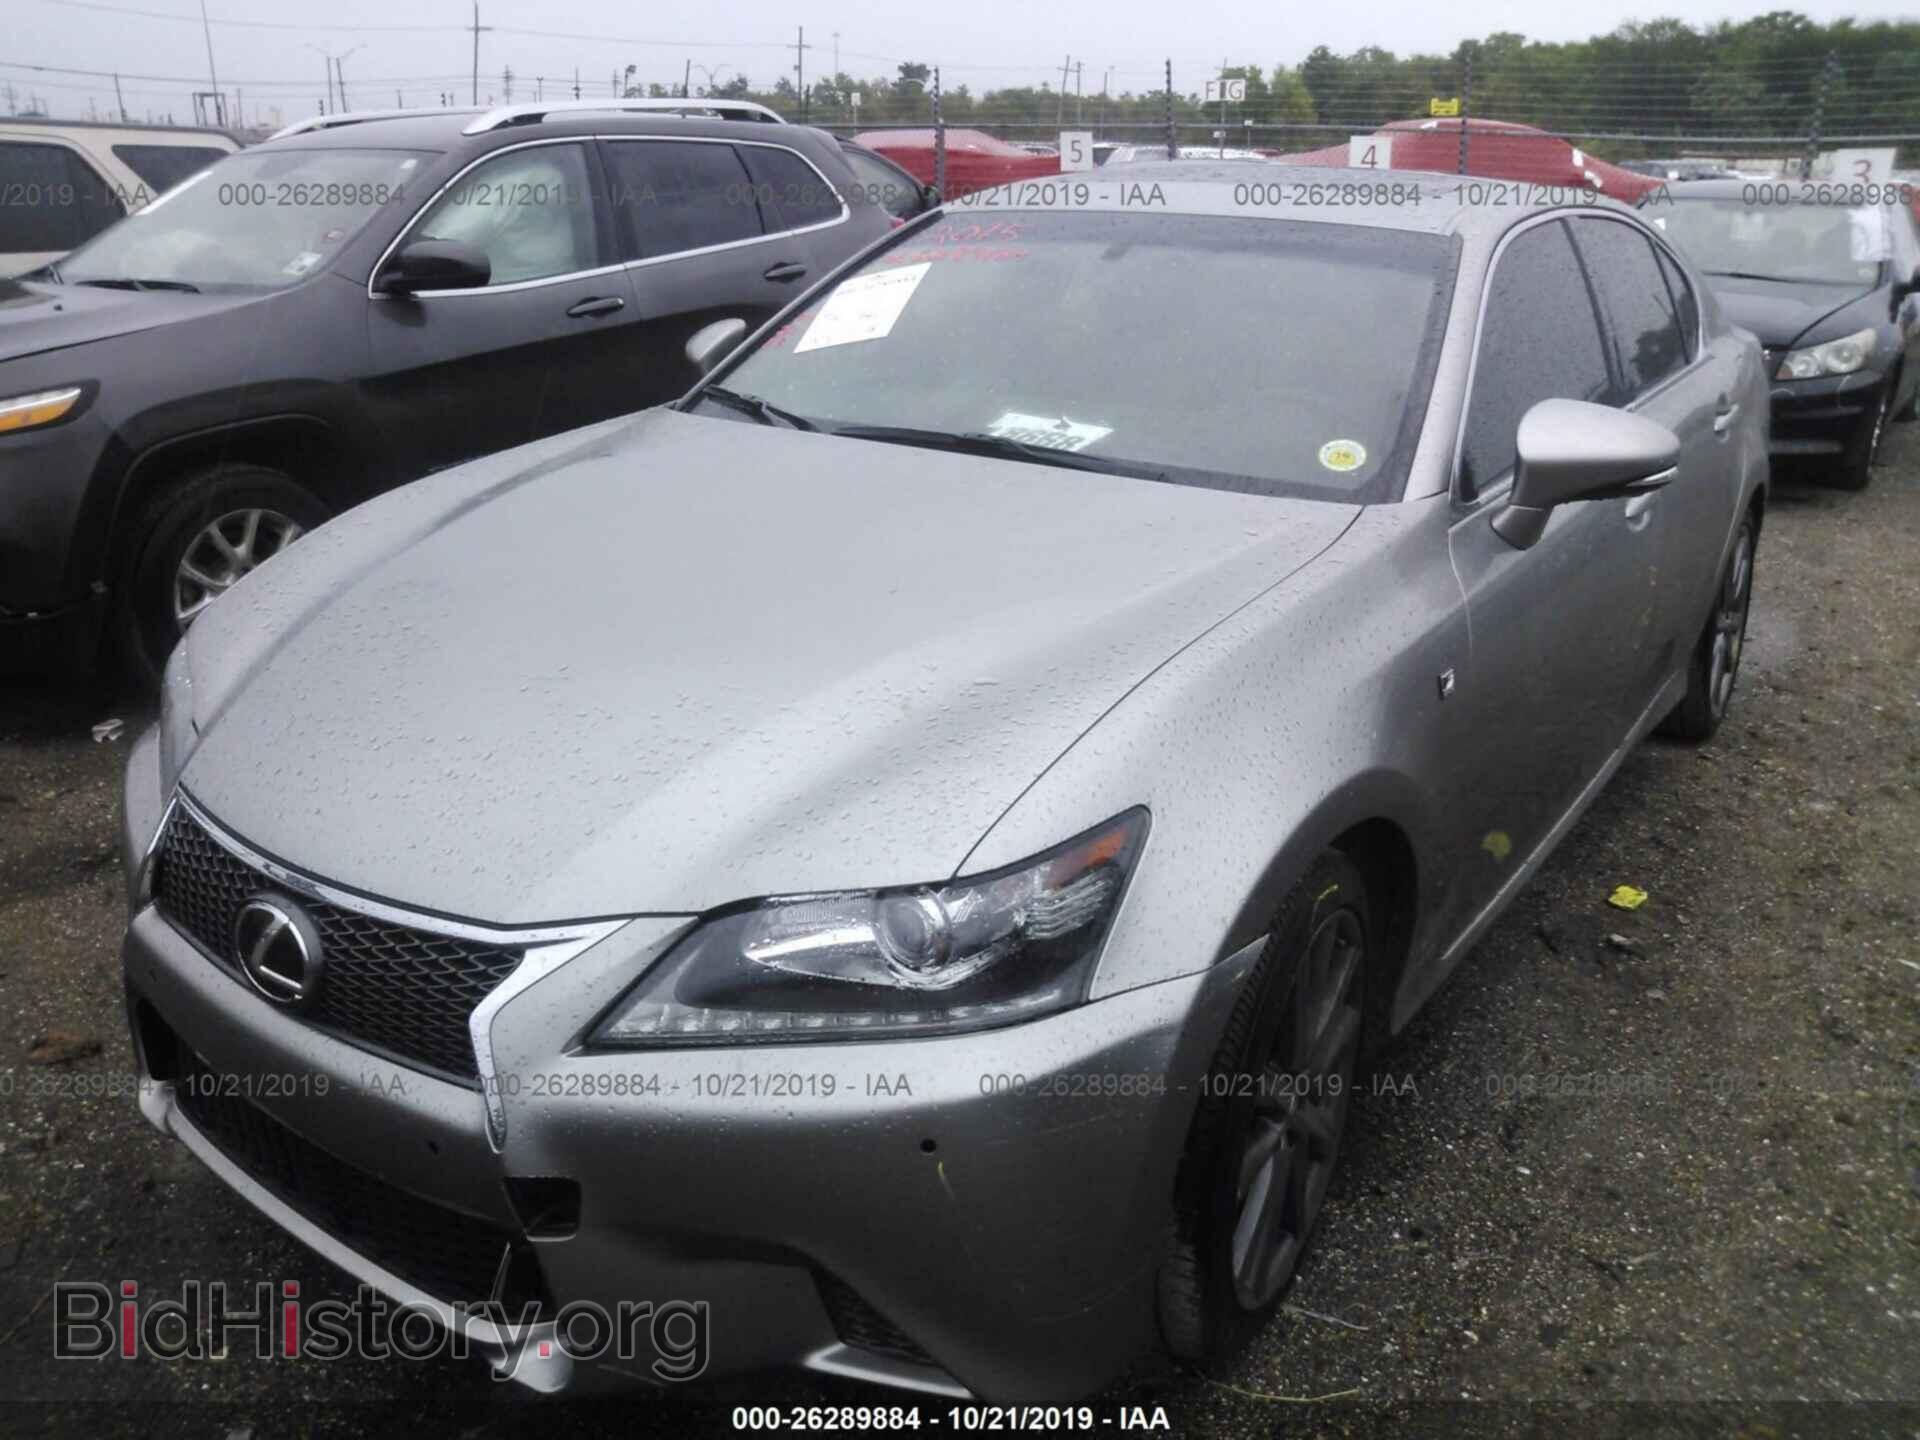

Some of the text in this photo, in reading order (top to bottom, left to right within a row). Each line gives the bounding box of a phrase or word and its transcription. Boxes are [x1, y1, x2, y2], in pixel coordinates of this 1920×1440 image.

[1206, 80, 1243, 100] F G
[1071, 140, 1082, 163] 5
[1361, 145, 1378, 169] 4
